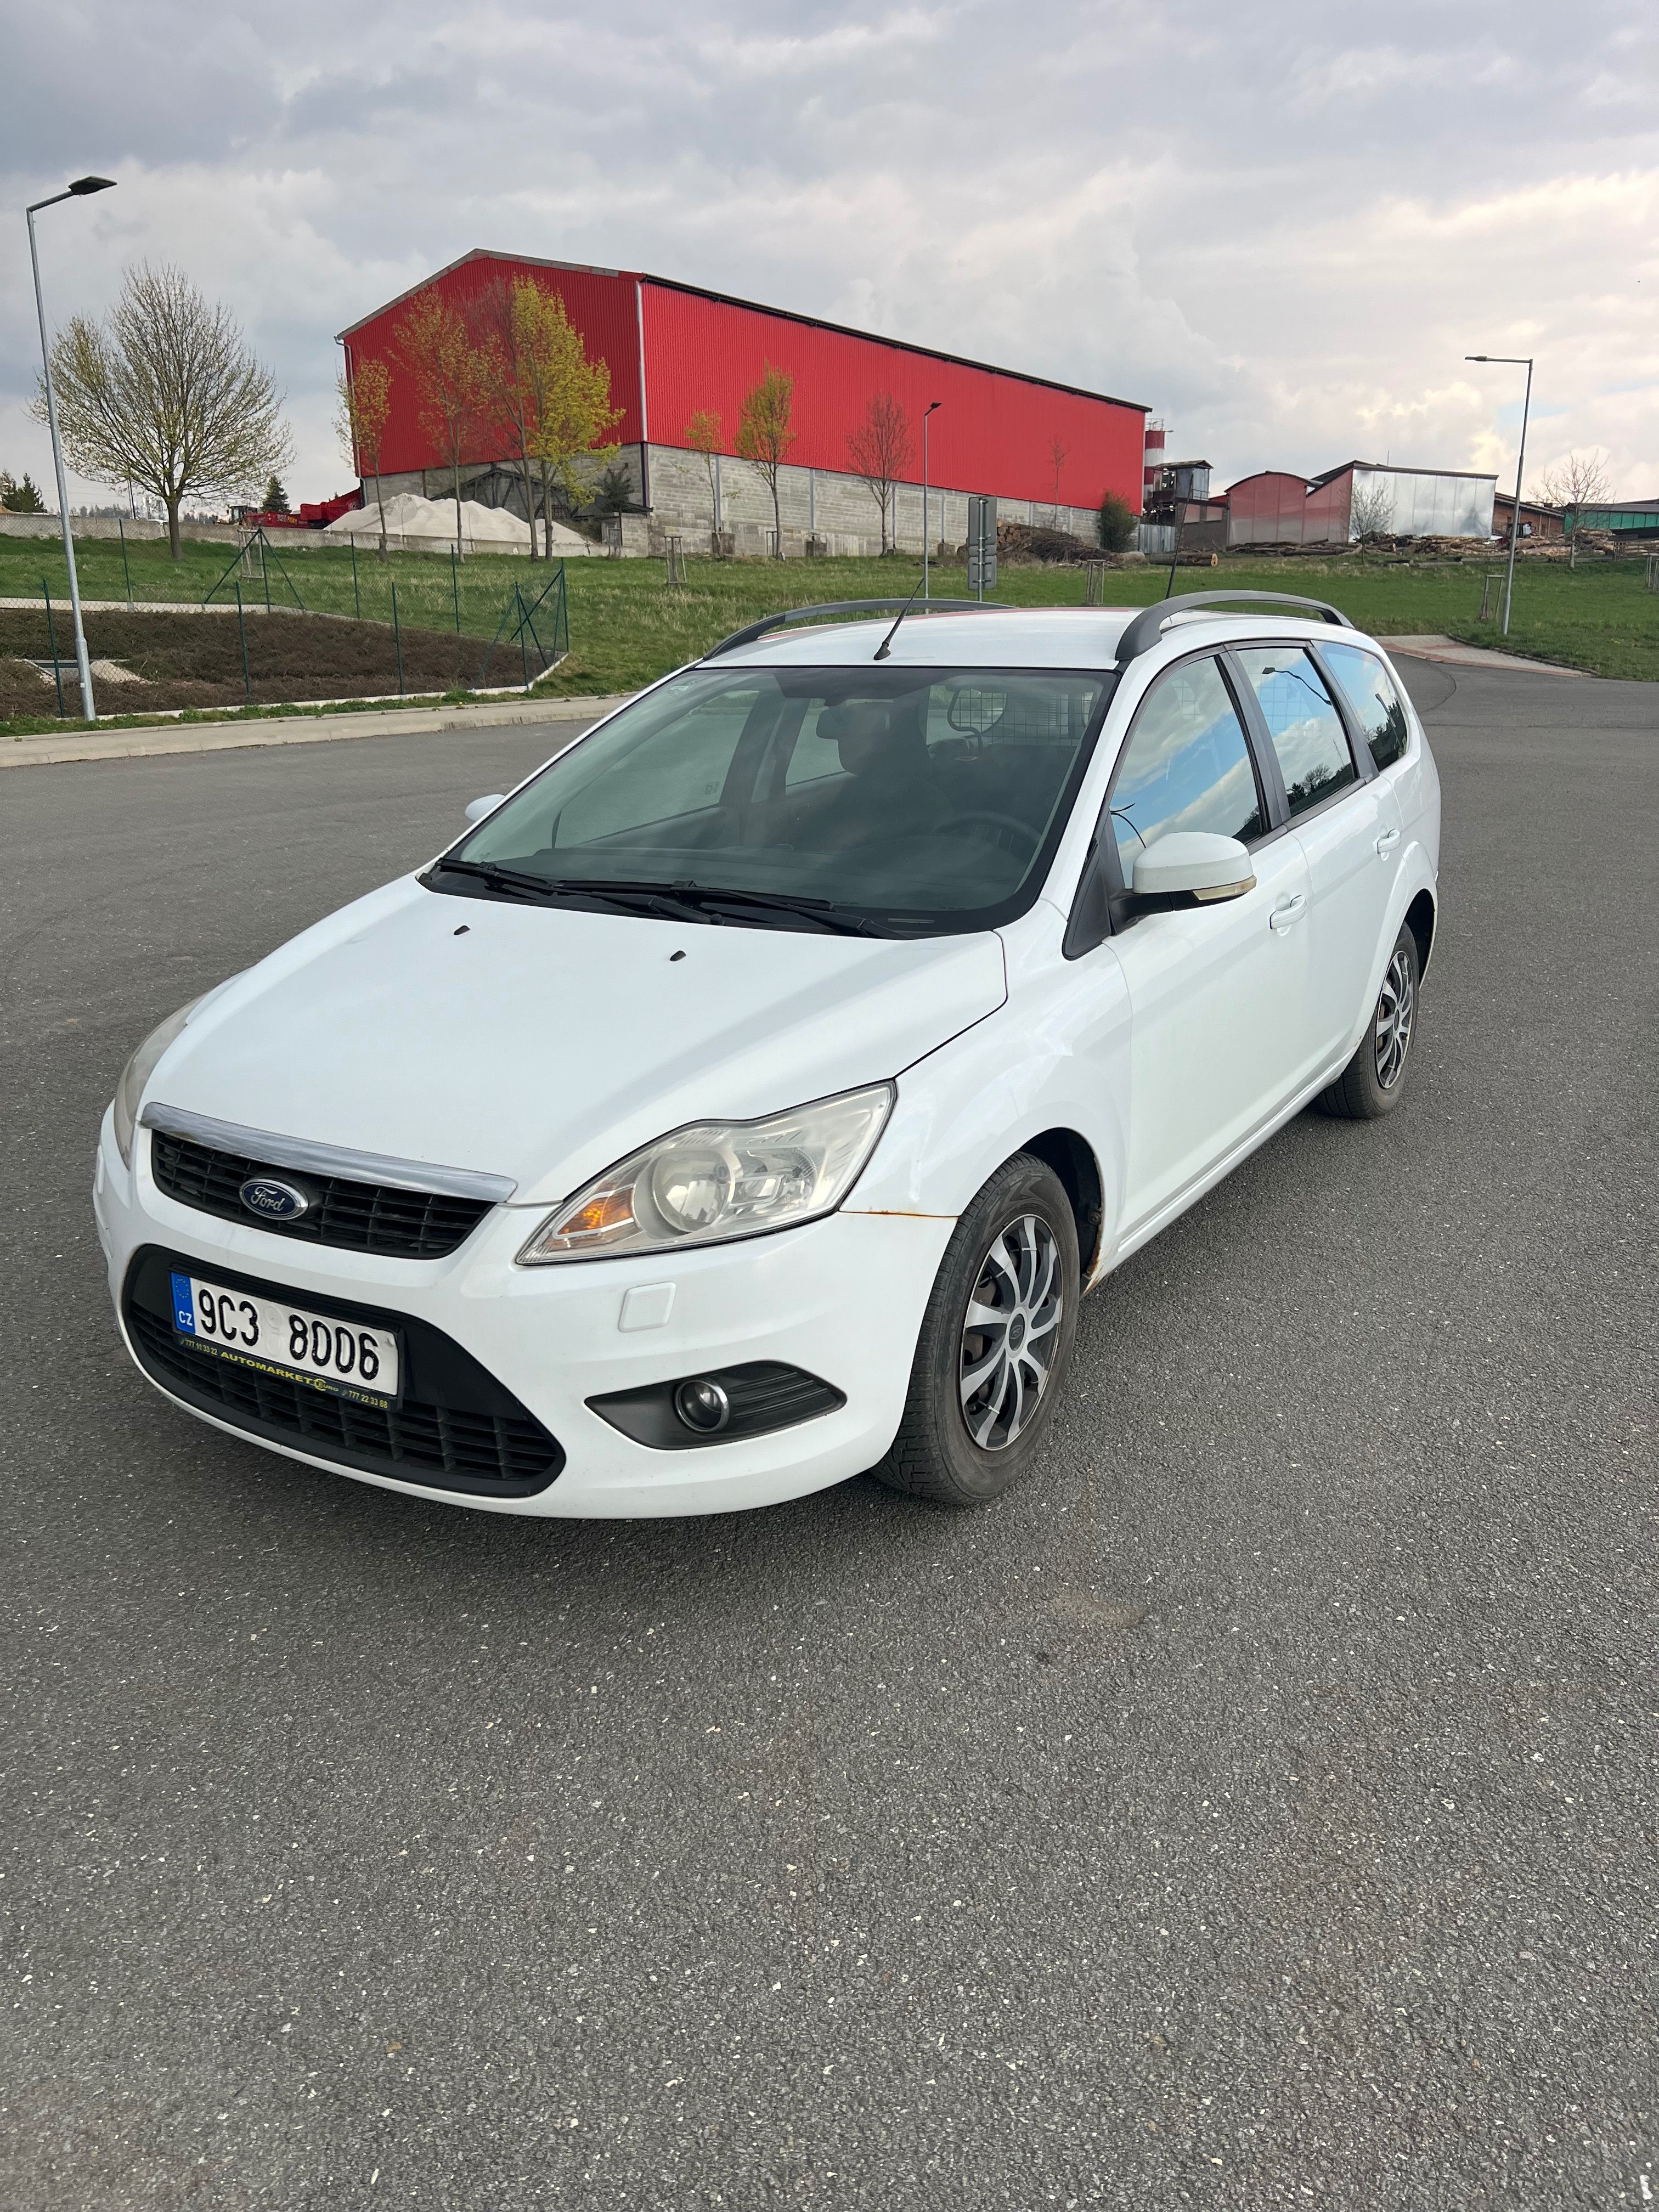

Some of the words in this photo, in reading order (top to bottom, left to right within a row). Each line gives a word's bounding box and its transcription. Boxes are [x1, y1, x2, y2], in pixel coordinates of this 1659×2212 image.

[251, 1186, 285, 1211] Ford
[178, 1310, 193, 1327] CZ
[199, 1289, 260, 1346] 9C3
[289, 1314, 379, 1380] 8006
[221, 1351, 311, 1384] AUTOMARKET
[360, 1394, 369, 1403] 22
